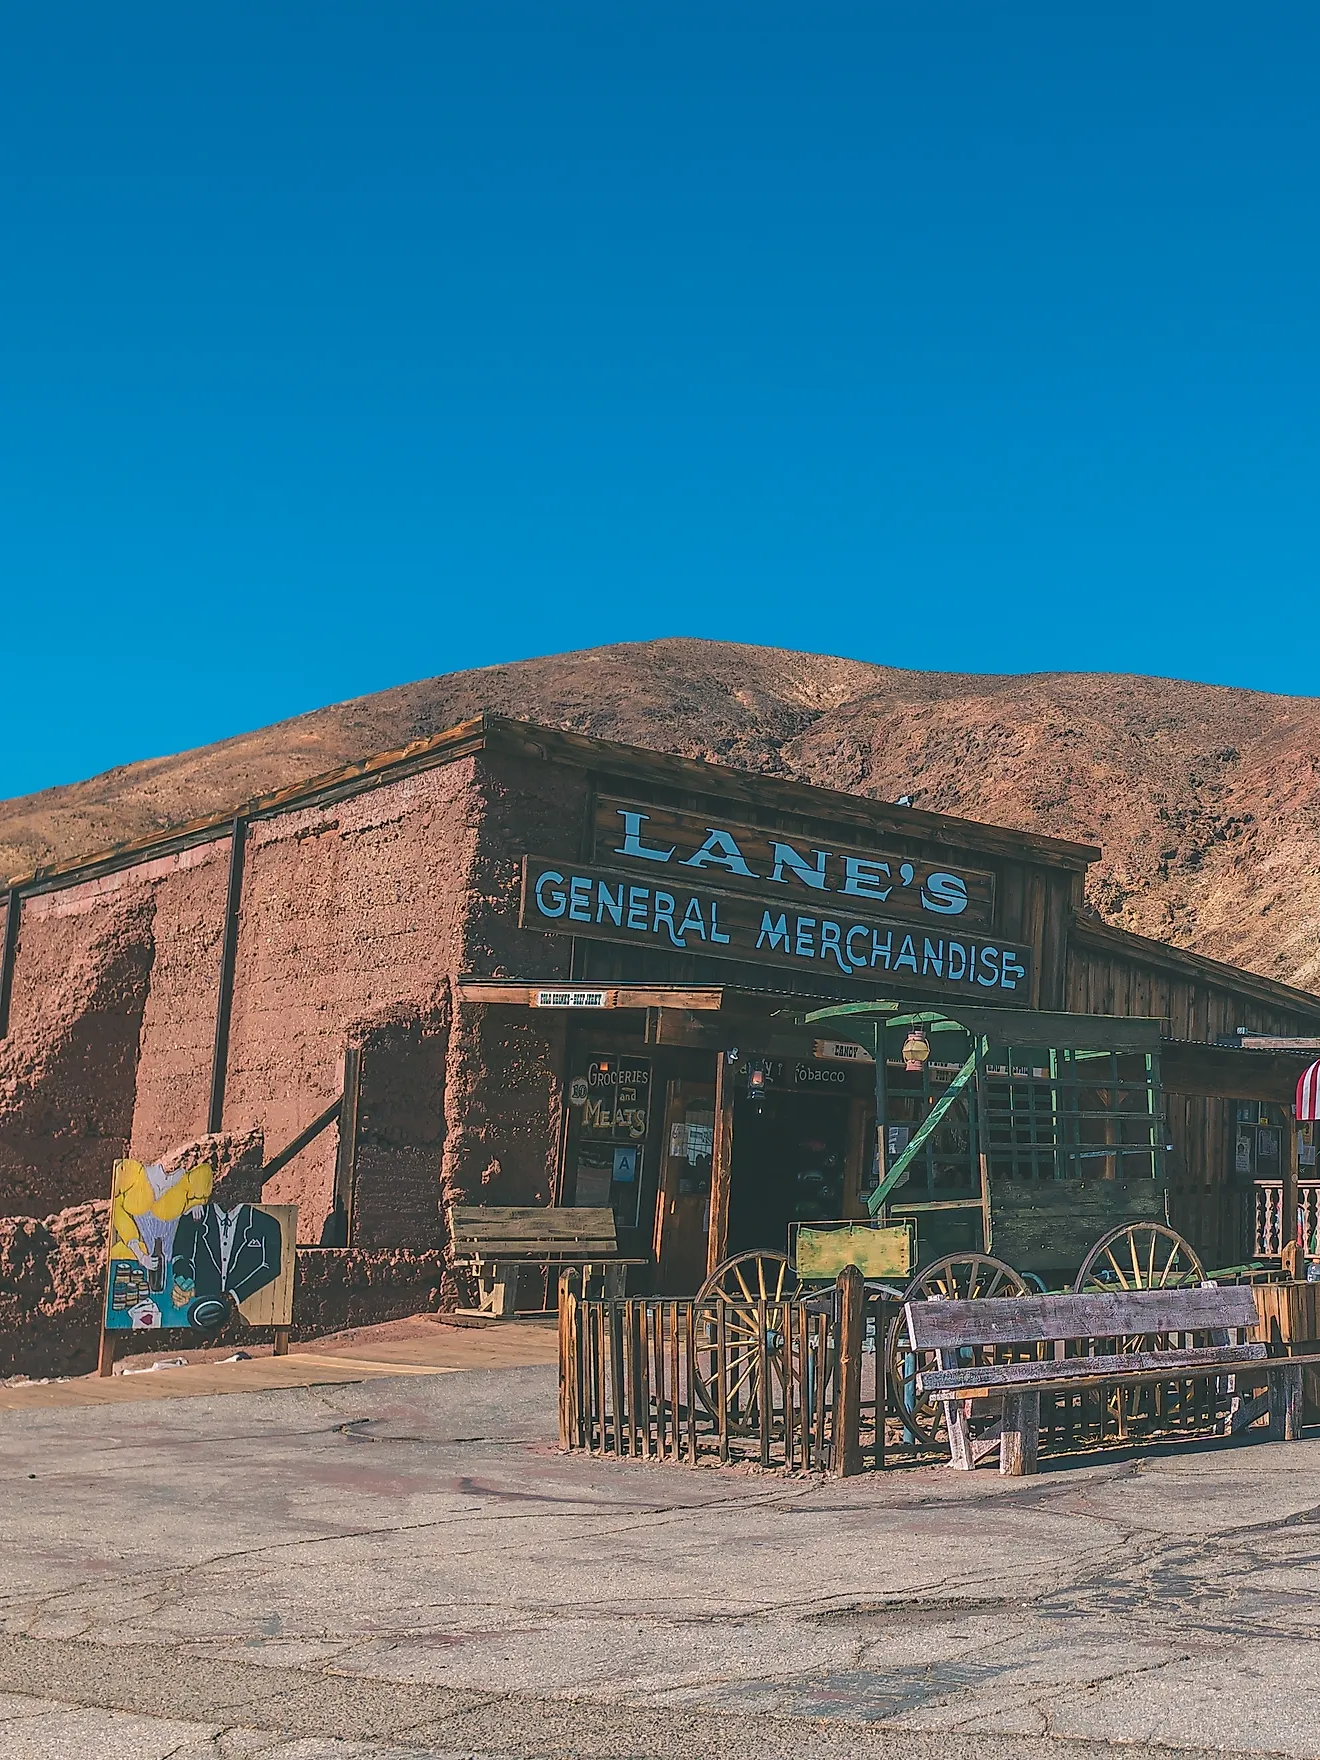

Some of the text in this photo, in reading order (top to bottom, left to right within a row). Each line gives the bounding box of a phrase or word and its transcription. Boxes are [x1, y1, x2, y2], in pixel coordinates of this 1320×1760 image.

[613, 809, 969, 916] LANE'S
[535, 870, 1027, 990] GENERAL MERCHANDISE
[834, 1044, 860, 1058] CANDY
[619, 1087, 637, 1102] and
[619, 1156, 630, 1170] A
